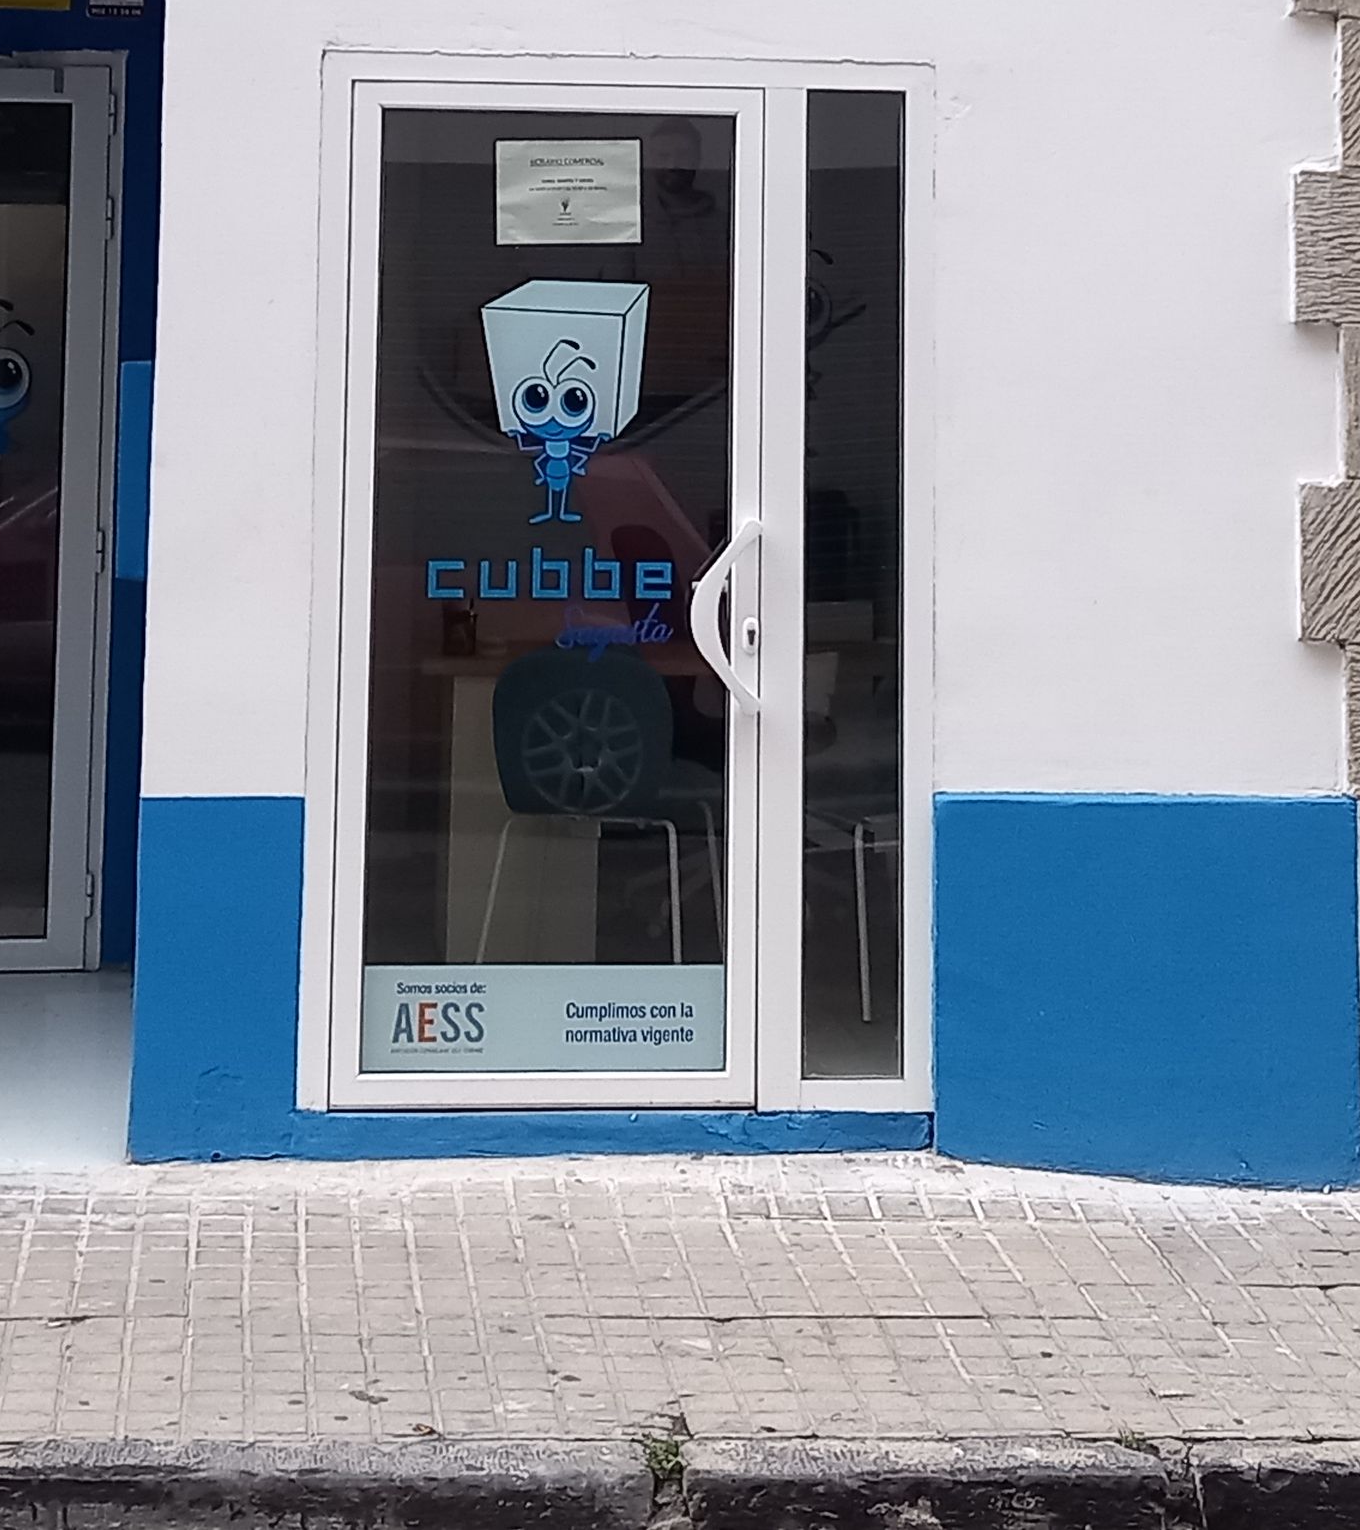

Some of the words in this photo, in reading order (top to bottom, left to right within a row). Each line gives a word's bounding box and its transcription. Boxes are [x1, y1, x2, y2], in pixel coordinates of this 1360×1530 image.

[425, 546, 673, 601] cubbe
[396, 981, 432, 995] Somos
[434, 982, 468, 995] socios
[470, 982, 487, 995] de:
[392, 1002, 486, 1044] AESS
[565, 1001, 646, 1023] Cumplimos
[649, 1004, 676, 1019] con
[679, 1002, 694, 1019] la
[565, 1026, 638, 1044] normativa
[641, 1026, 694, 1046] vigente
